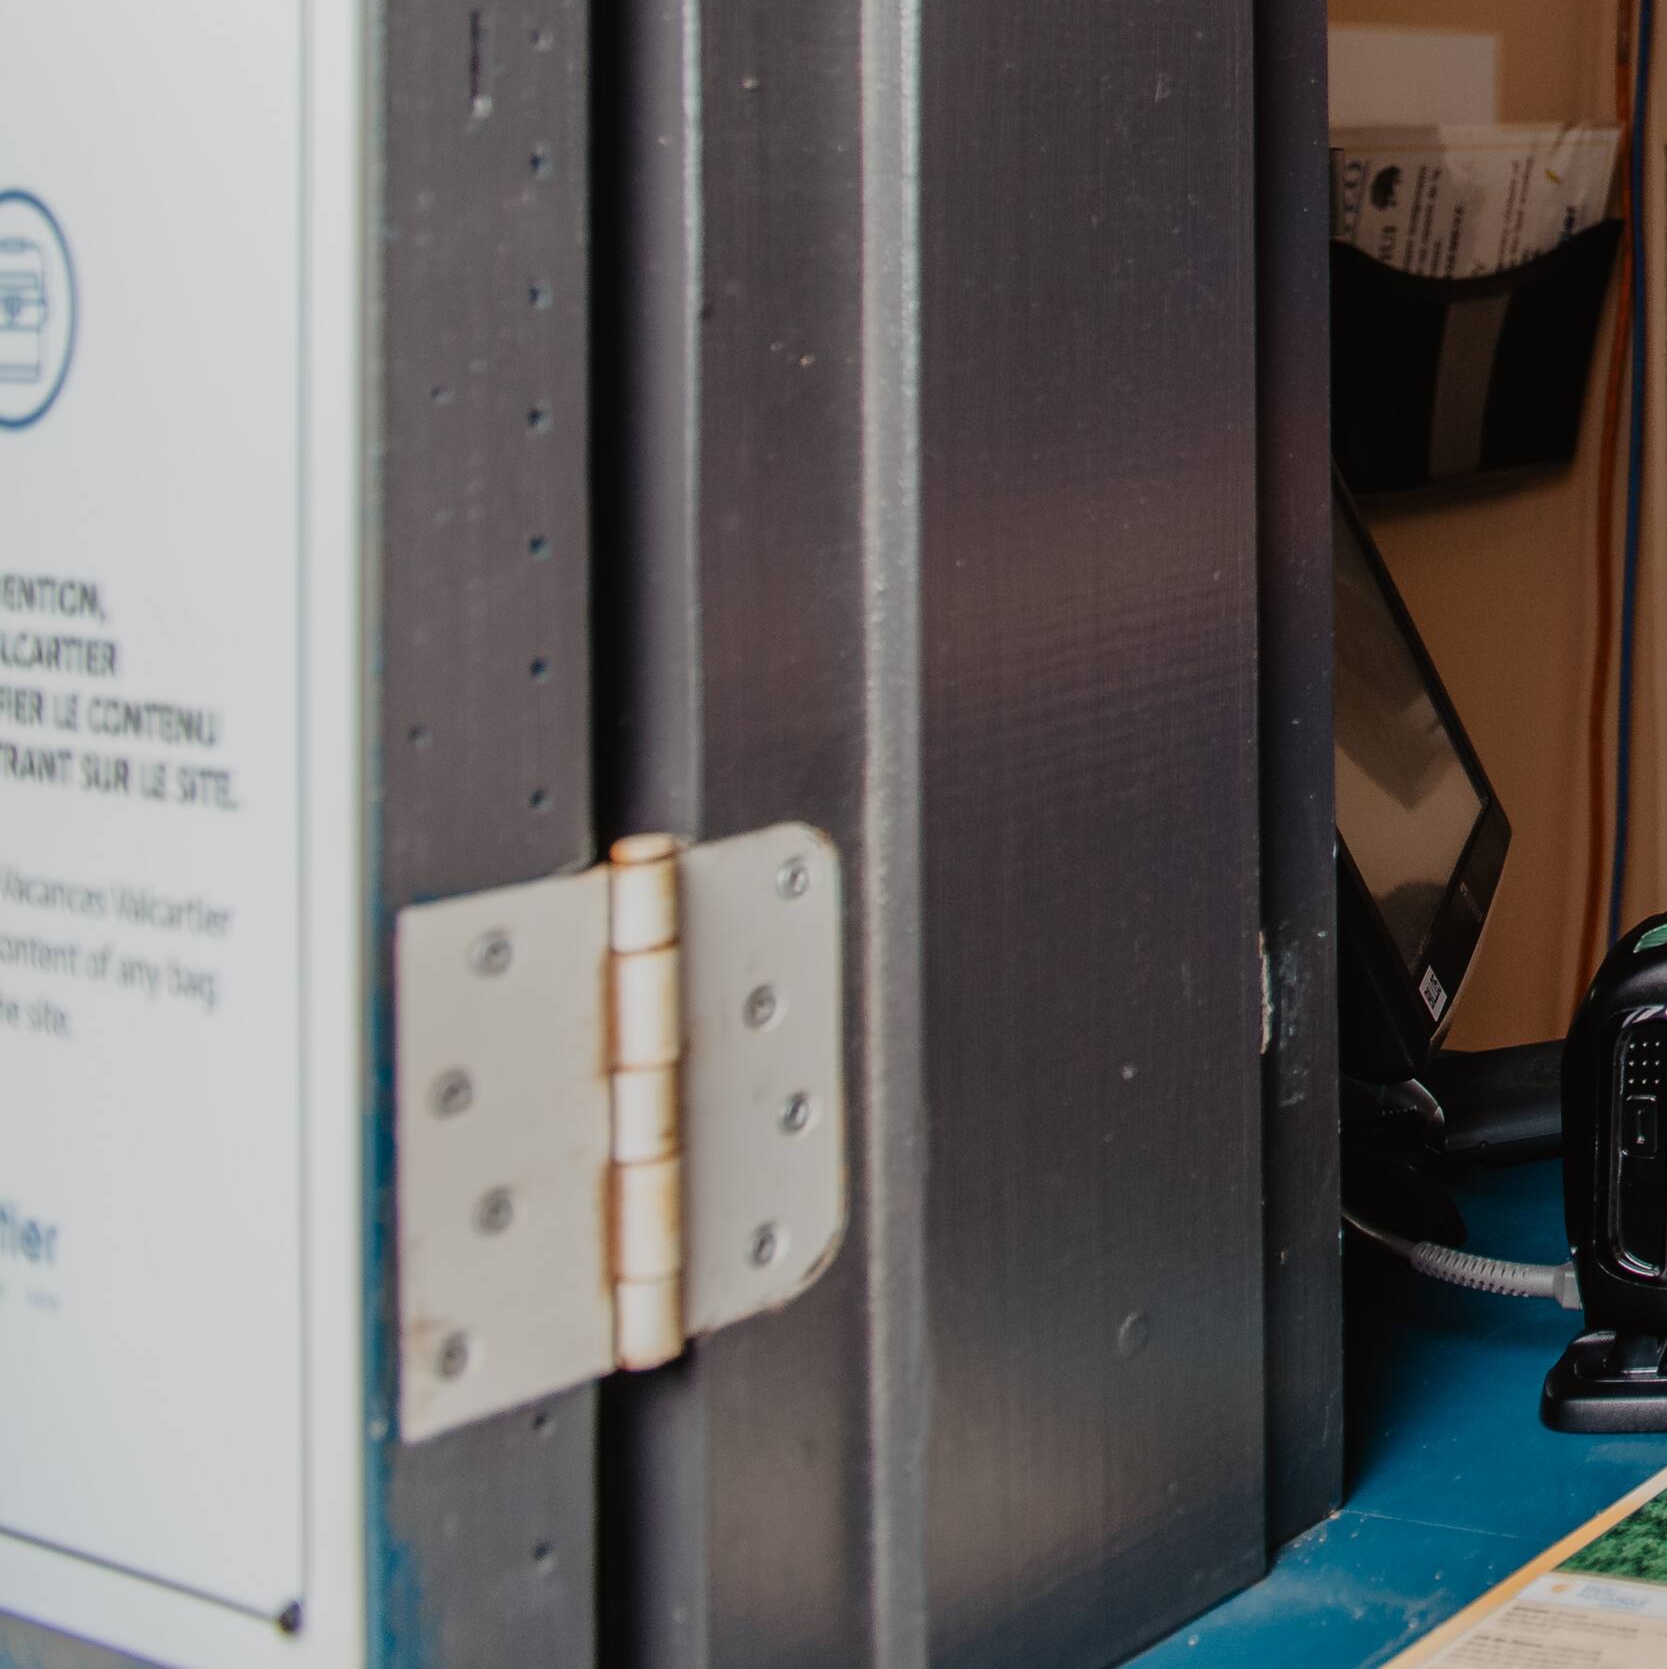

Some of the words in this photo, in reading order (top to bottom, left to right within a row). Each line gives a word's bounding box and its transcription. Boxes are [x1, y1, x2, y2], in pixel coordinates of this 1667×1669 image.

[53, 693, 78, 732] LE
[87, 696, 217, 748] CONTENU
[80, 751, 130, 793] SUR
[140, 761, 166, 801] LE
